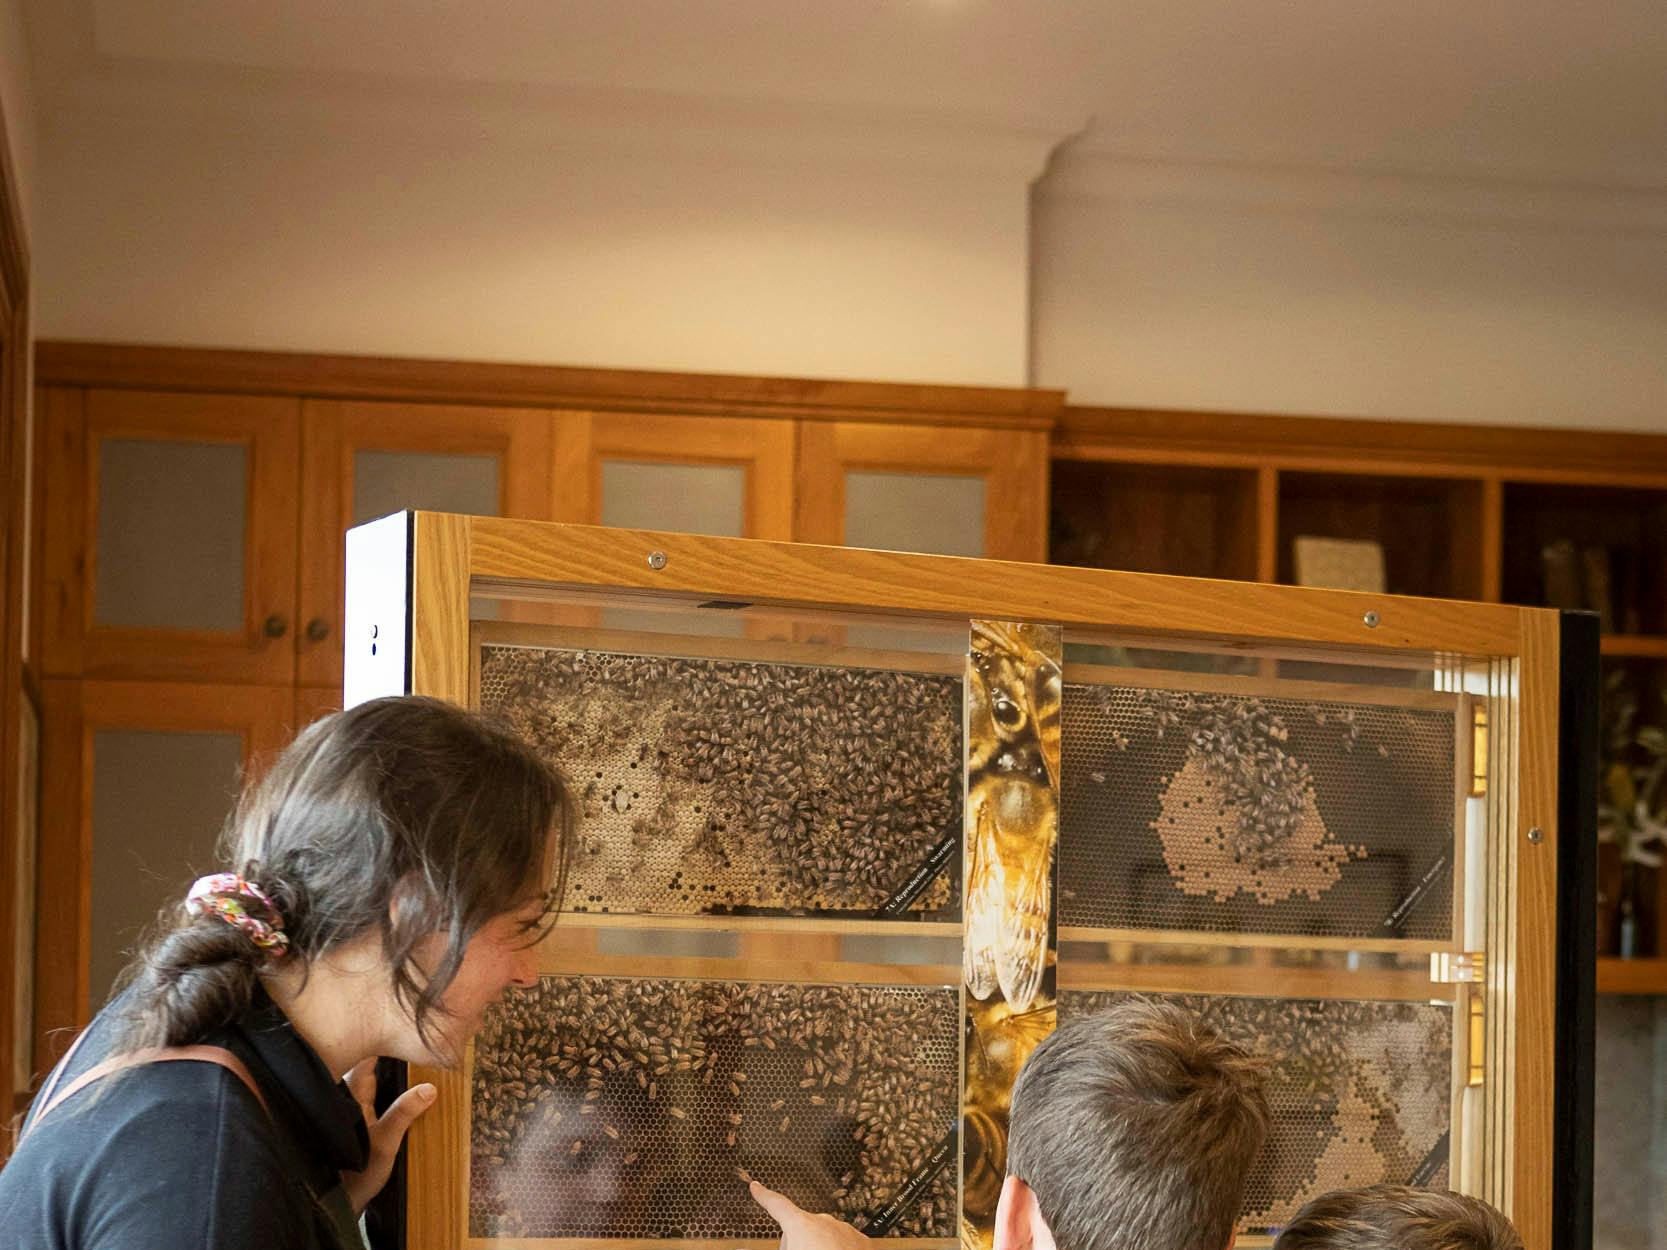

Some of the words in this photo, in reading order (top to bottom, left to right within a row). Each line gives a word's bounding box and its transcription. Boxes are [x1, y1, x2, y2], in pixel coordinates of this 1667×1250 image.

[895, 868, 928, 903] Reproduction
[930, 837, 956, 864] Swarming
[883, 1201, 898, 1218] Inner
[897, 1184, 914, 1202] Brood
[911, 1167, 929, 1186] Frame
[931, 1145, 949, 1163] Queen
